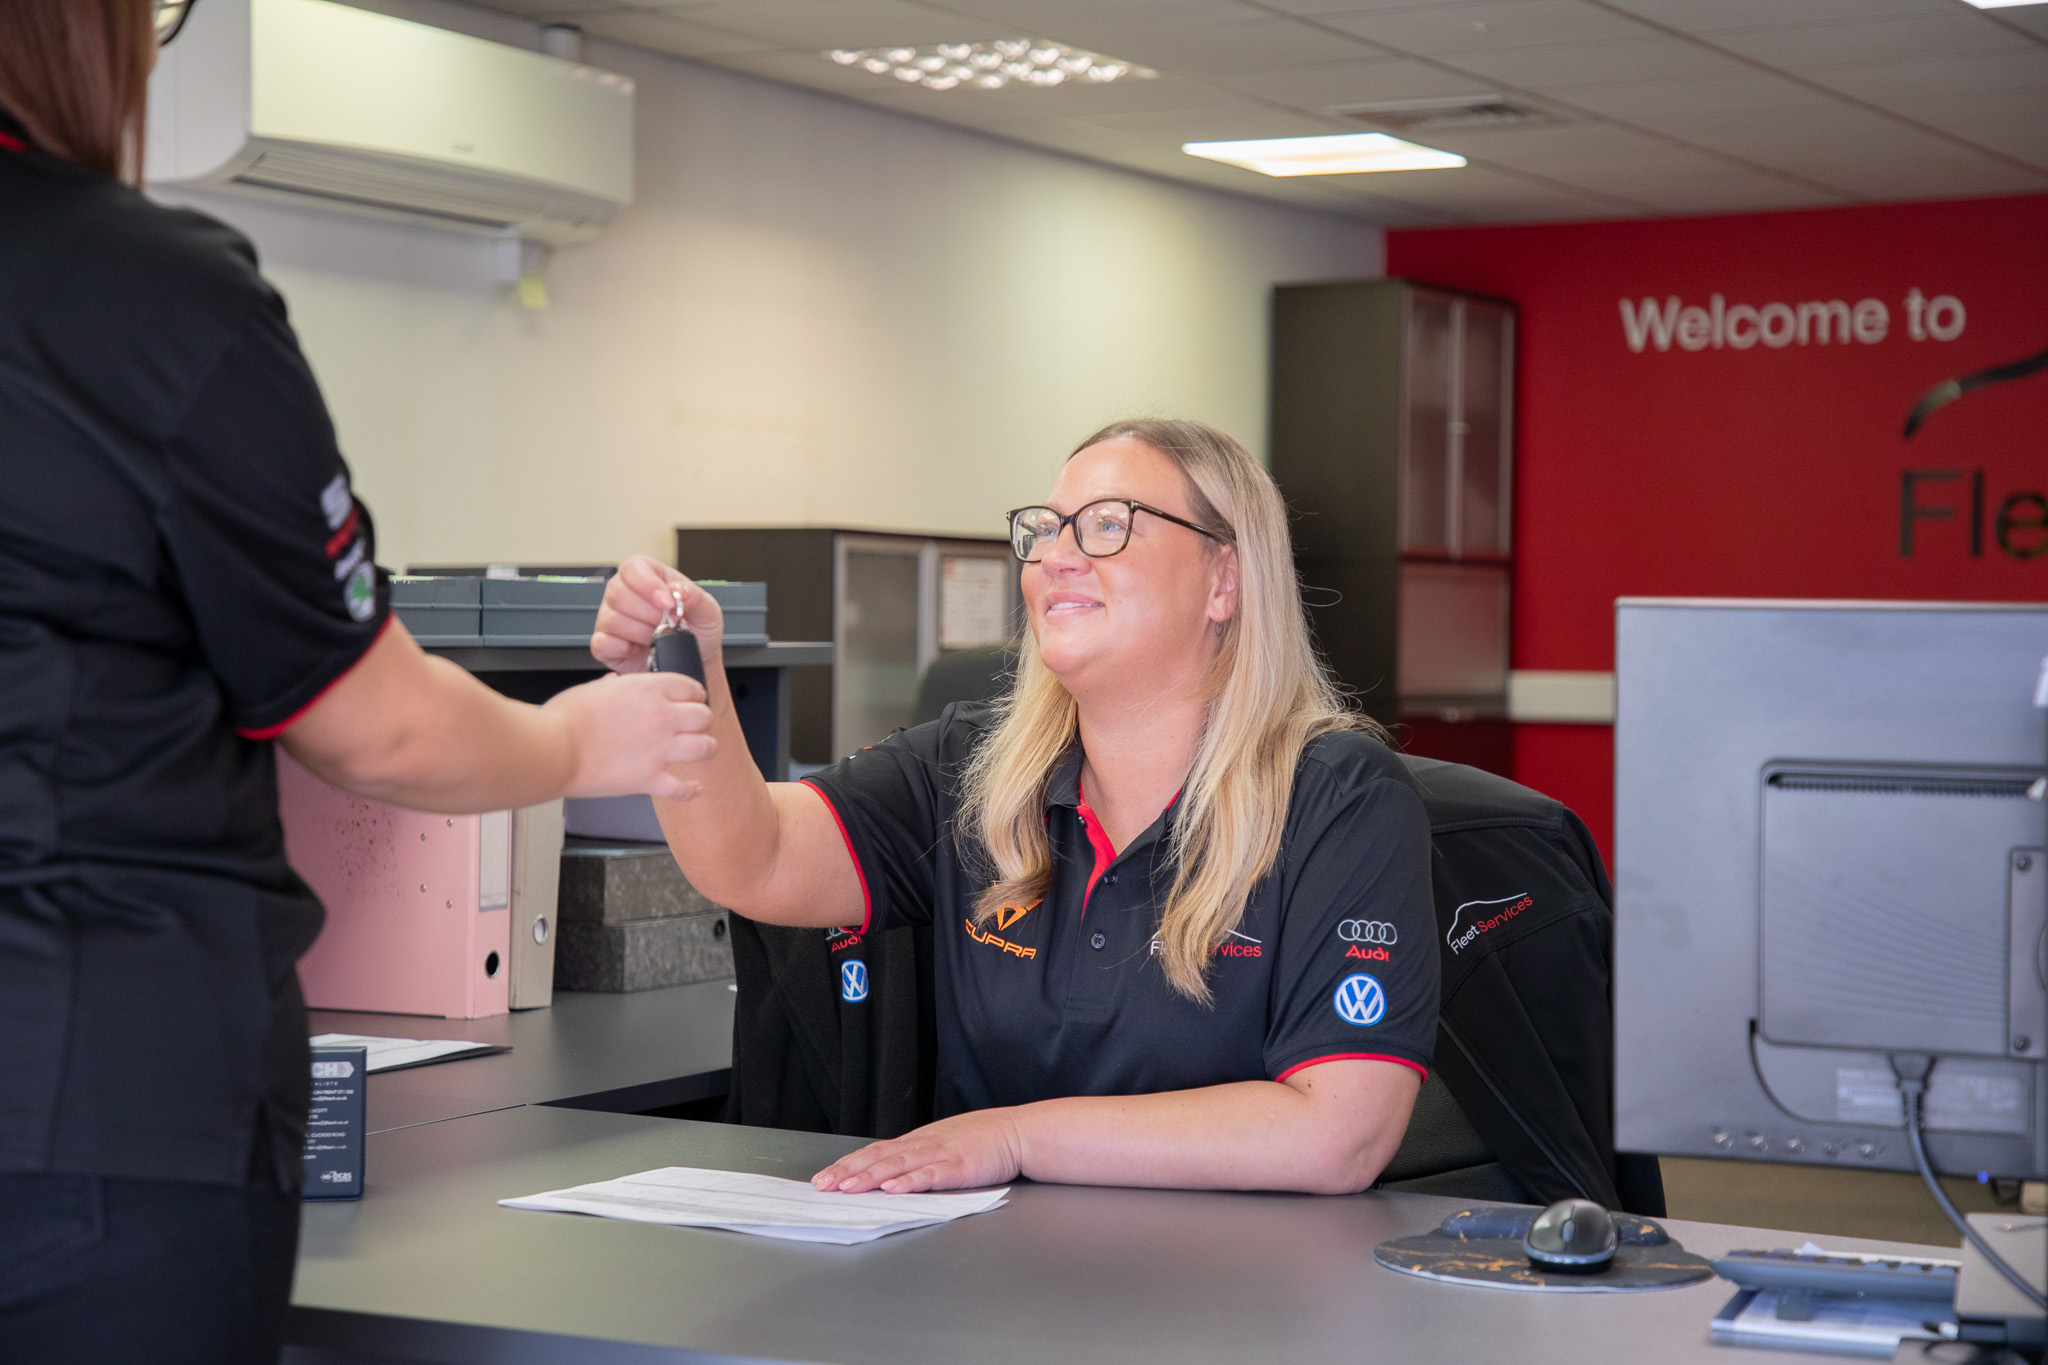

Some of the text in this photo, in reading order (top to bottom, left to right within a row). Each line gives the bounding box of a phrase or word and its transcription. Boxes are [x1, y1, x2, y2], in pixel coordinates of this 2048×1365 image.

[1619, 287, 1967, 353] Welcome to
[831, 934, 862, 953] Audi
[965, 918, 1037, 960] CUPRA
[1345, 944, 1390, 962] Audi
